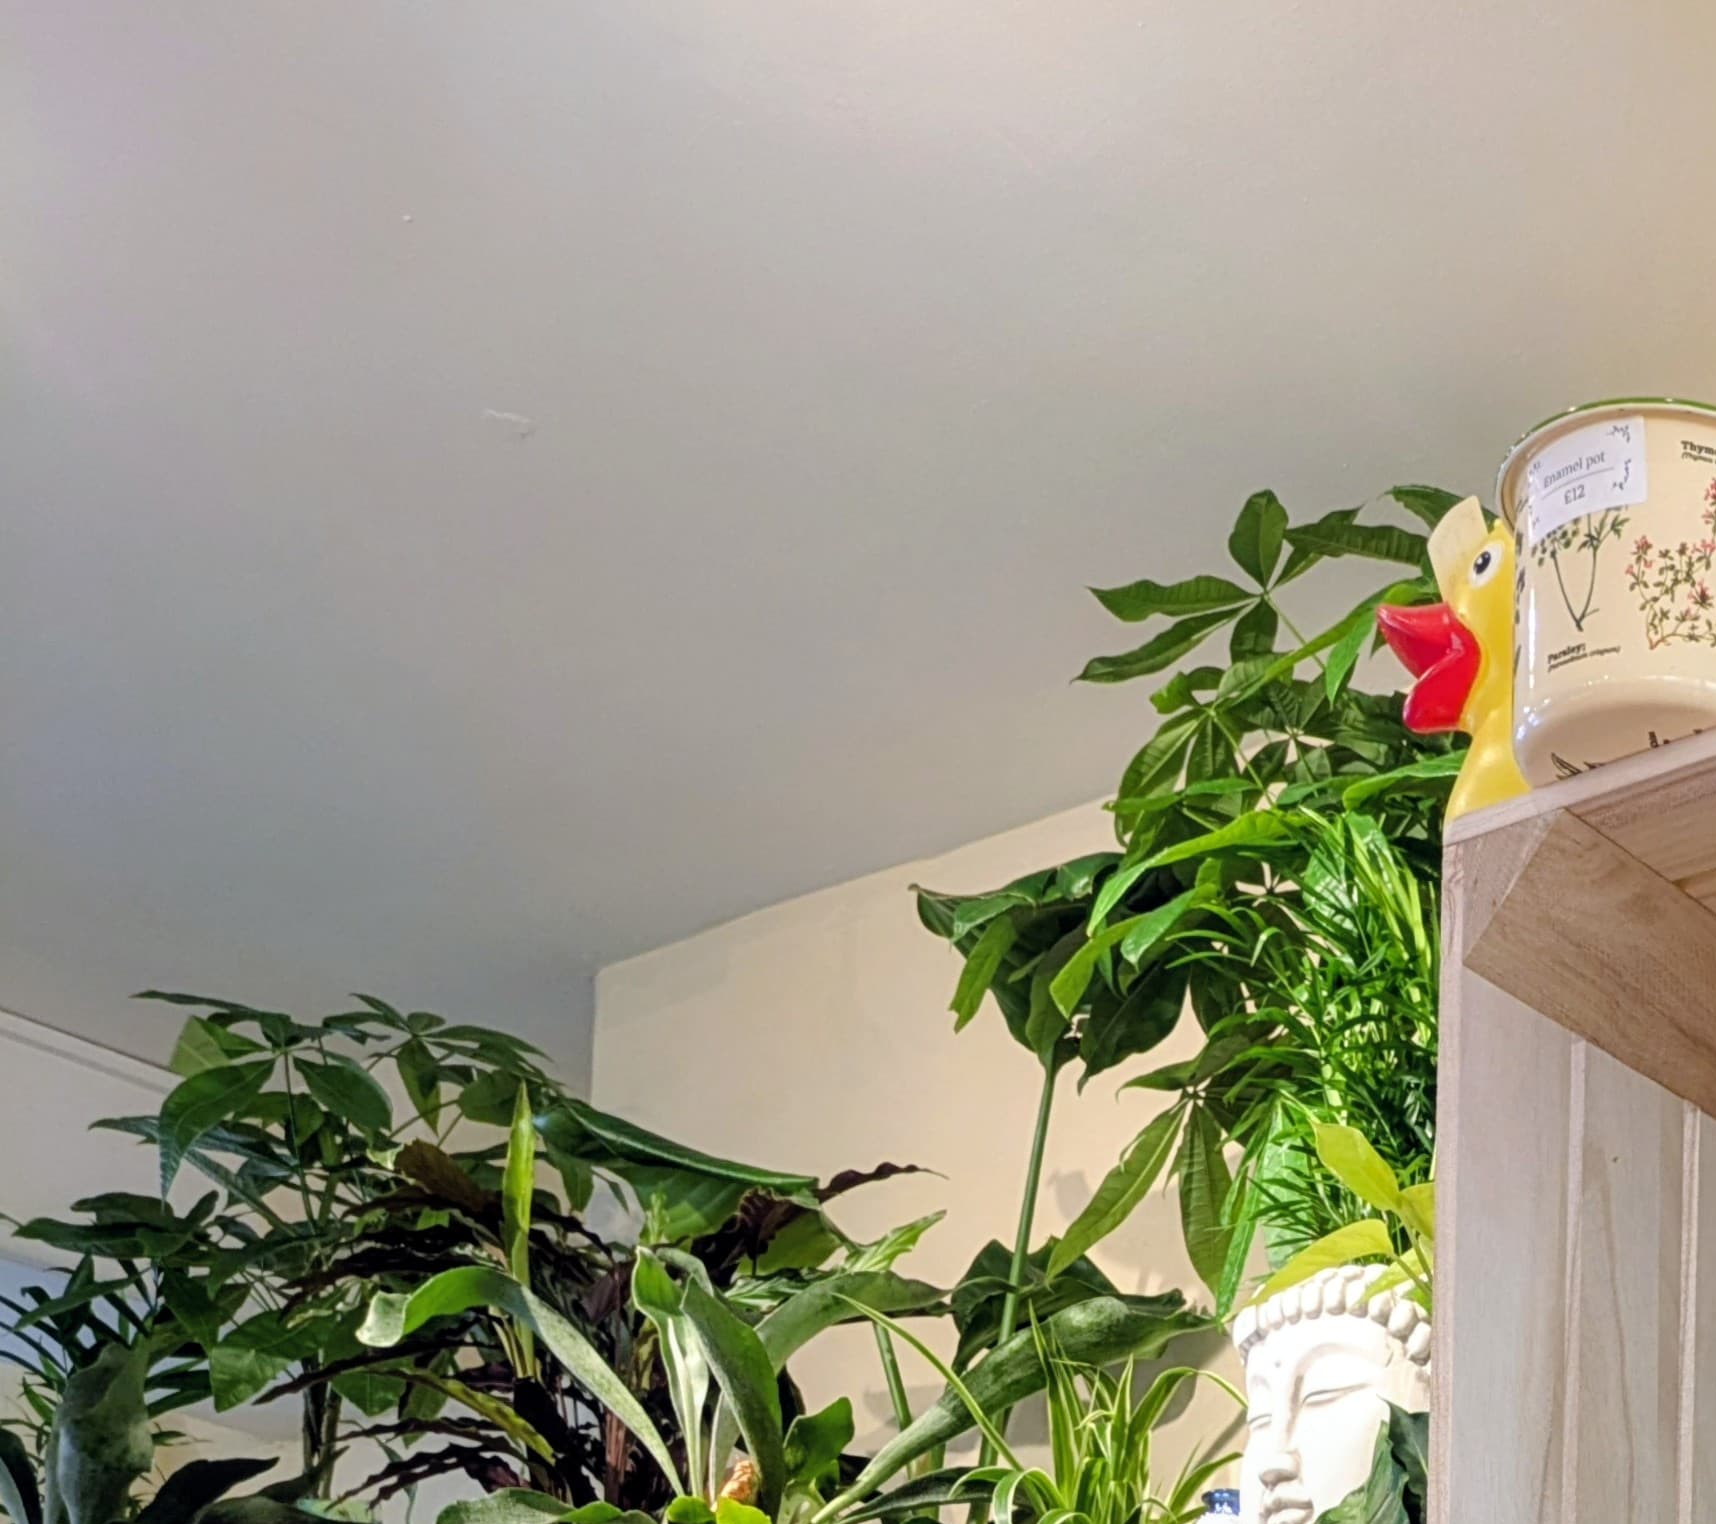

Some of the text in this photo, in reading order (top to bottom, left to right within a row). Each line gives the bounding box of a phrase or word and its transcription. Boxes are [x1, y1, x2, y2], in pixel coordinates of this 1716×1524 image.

[1543, 451, 1606, 489] Enamel pot
[1564, 484, 1586, 505] £12
